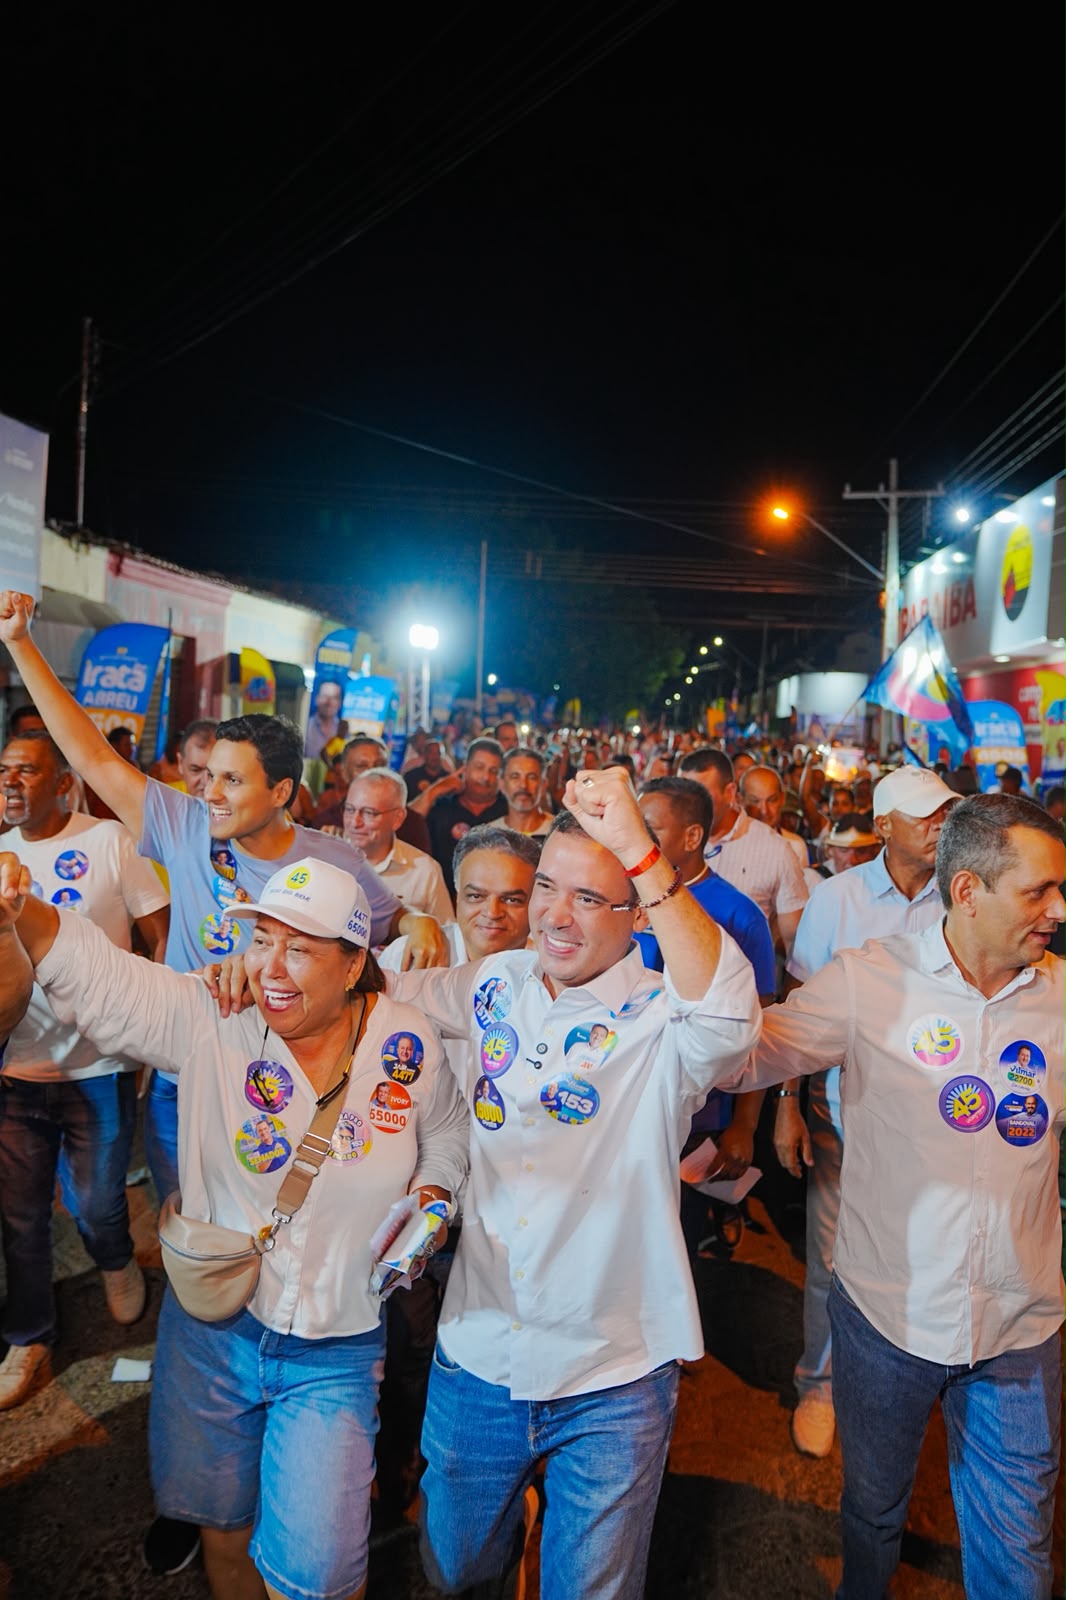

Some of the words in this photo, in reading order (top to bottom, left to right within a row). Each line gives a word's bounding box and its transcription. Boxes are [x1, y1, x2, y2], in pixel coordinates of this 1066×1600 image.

[291, 873, 308, 884] 45
[483, 1037, 508, 1062] 45
[913, 1025, 957, 1057] 45
[392, 1069, 415, 1082] 4477
[1010, 1072, 1034, 1087] 22700
[390, 1096, 409, 1105] IVORY
[558, 1090, 594, 1115] 153
[952, 1086, 983, 1121] 45
[369, 1108, 407, 1132] 65000
[1008, 1127, 1036, 1137] 2022
[249, 1147, 287, 1167] SENADOR
